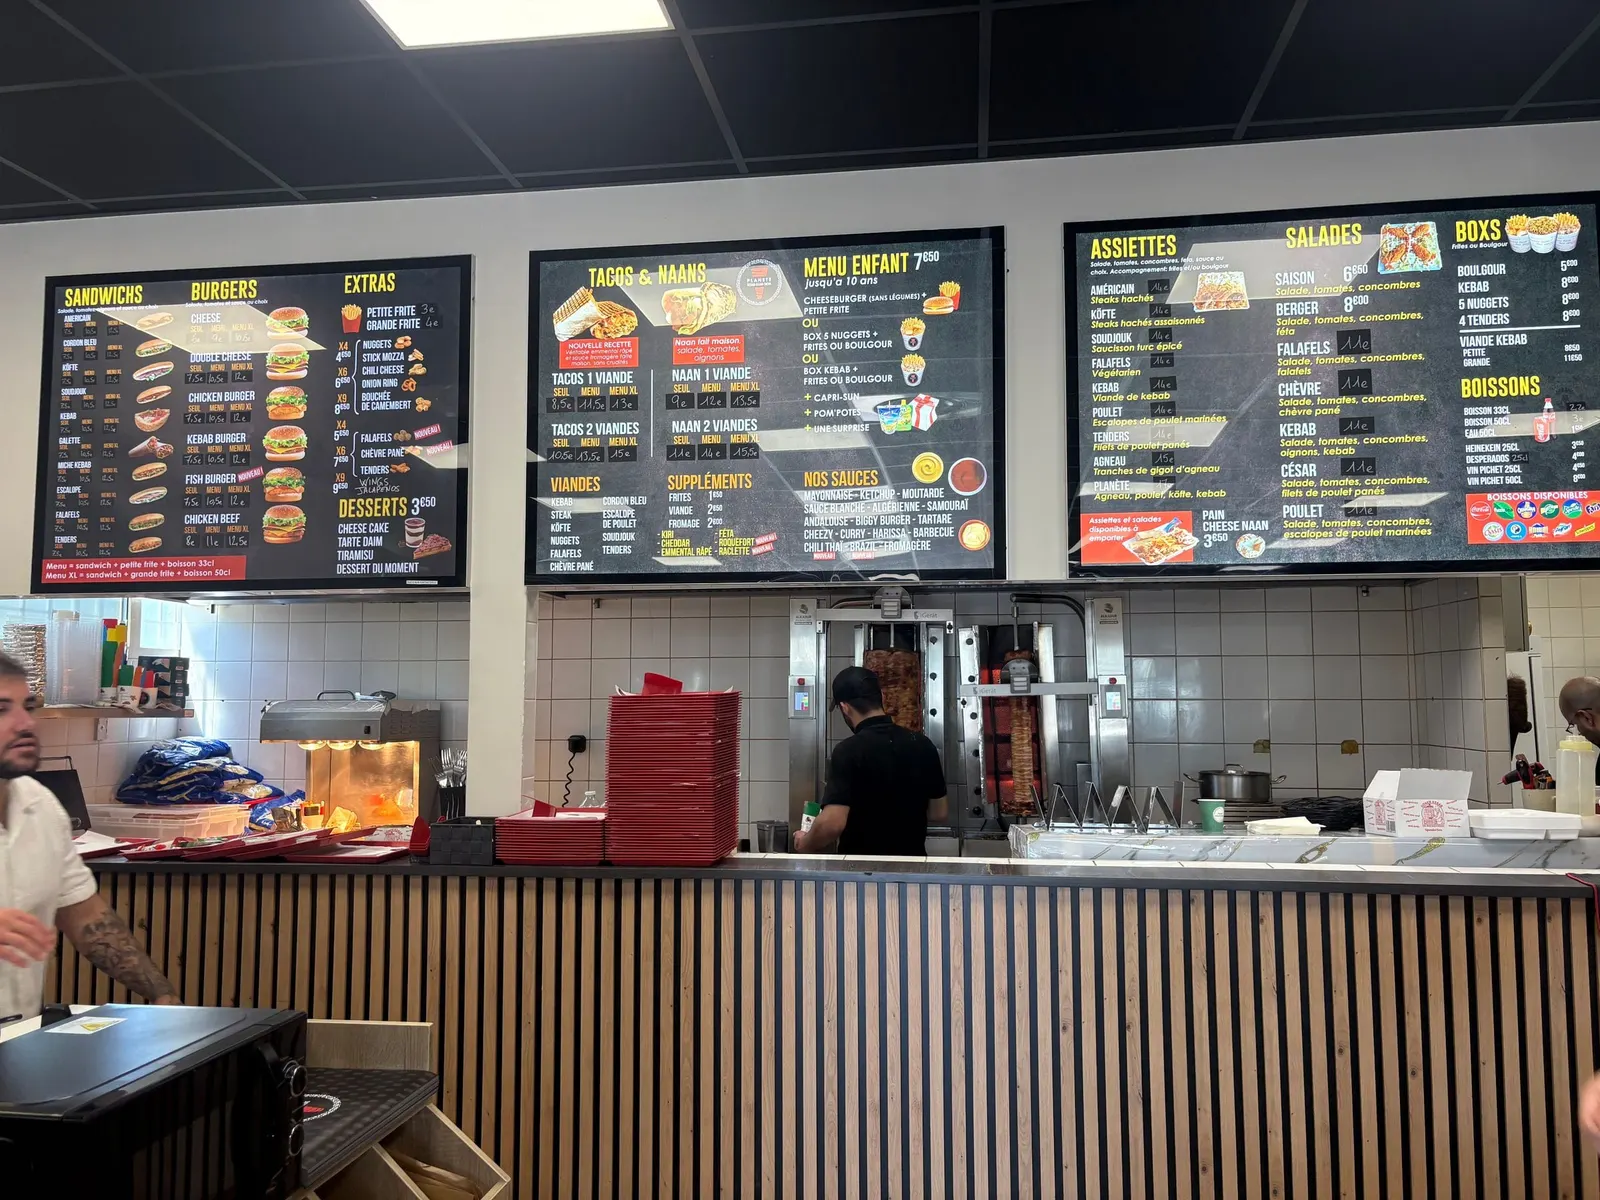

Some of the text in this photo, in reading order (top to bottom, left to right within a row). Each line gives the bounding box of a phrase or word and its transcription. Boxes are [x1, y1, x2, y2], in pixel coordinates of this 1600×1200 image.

[1286, 223, 1362, 248] SALADES
[1456, 219, 1501, 242] BOXS
[1091, 235, 1176, 260] ASSIETTES
[804, 256, 846, 277] MENU
[852, 253, 909, 275] ENFANT
[1458, 264, 1506, 276] BOULGOUR
[589, 263, 706, 288] TACOS & NAANS
[846, 277, 857, 285] 10
[860, 276, 878, 284] ans
[1276, 271, 1314, 286] SAISON
[344, 273, 395, 293] EXTRAS
[1458, 281, 1489, 293] KEBAB
[192, 280, 257, 300] BURGERS
[1091, 283, 1134, 296] AMÉRICAIN
[65, 285, 143, 307] SANDWICHS
[804, 295, 866, 304] CHEESEBURGER
[1091, 294, 1154, 304] Steaks hachés
[1276, 301, 1318, 316] BERGER
[1459, 297, 1509, 309] 5 NUGGETS
[367, 306, 416, 317] PETITE FRITE
[367, 319, 420, 330] GRANDE FRITE
[802, 319, 818, 328] OU
[1459, 314, 1509, 326] 4 TENDERS
[831, 331, 870, 339] NUGGETS
[1092, 333, 1132, 344] SOUDJOUK
[363, 340, 392, 349] NUGGETS
[1460, 334, 1527, 348] VIANDE KEBAB
[1092, 341, 1182, 353] Saucisson turc épicé
[1277, 341, 1330, 356] FALAFELS
[362, 352, 404, 362] STICK MOZZA
[552, 371, 633, 385] TACOS 1 VIANDE
[672, 367, 751, 382] NAAN 1 VIANDE
[1092, 369, 1140, 378] Végétarien
[362, 378, 398, 388] ONION RING
[1278, 380, 1321, 396] CHÈVRE
[1462, 376, 1540, 398] BOISSONS
[189, 391, 255, 402] CHICKEN BURGER
[554, 388, 569, 396] SEUL
[581, 387, 600, 395] MENU
[814, 393, 859, 402] CAPRI-SUN
[1093, 407, 1122, 418] POULET
[1464, 406, 1510, 415] BOISSON 33CL
[552, 422, 639, 436] TACOS 2 VIANDES
[1280, 423, 1316, 437] KEBAB
[187, 433, 246, 444] KEBAB BURGER
[361, 433, 392, 442] FALAFELS
[1094, 456, 1126, 467] AGNEAU
[360, 466, 389, 475] TENDERS
[1094, 467, 1133, 476] Tranches
[1150, 466, 1173, 476] gigot
[1176, 465, 1220, 475] d'agneau
[1281, 462, 1316, 478] CÉSAR
[185, 474, 236, 484] FISH BURGER
[668, 472, 752, 490] SUPPLÉMENTS
[804, 470, 878, 487] NOS SAUCES
[551, 477, 600, 492] VIANDES
[669, 493, 691, 502] FRITES
[860, 488, 944, 500] KETCHUP MOUTARDE
[1534, 492, 1588, 500] DISPONIBLES
[339, 497, 407, 518] DESSERTS
[872, 500, 920, 512] ALGÉRIENNE
[1283, 504, 1323, 518] POULET
[185, 513, 240, 524] CHICKEN BEEF
[603, 510, 635, 518] ESCALOPE
[1203, 510, 1224, 520] PAIN
[669, 520, 700, 528] FROMAGE
[804, 514, 952, 527] ANDALOUSE BIGGY BURGER TARTARE
[338, 523, 389, 534] CHEESE CAKE
[1203, 521, 1268, 532] CHEESE NAAN
[840, 527, 954, 539] CURRY HARISSA BARBECUE
[338, 536, 382, 547] TARTE DAIM
[662, 539, 690, 547] CHEDDAR
[337, 550, 373, 560] TIRAMISU
[719, 547, 749, 555] RACLETTE
[337, 563, 419, 574] DESSERT DU MOMENT
